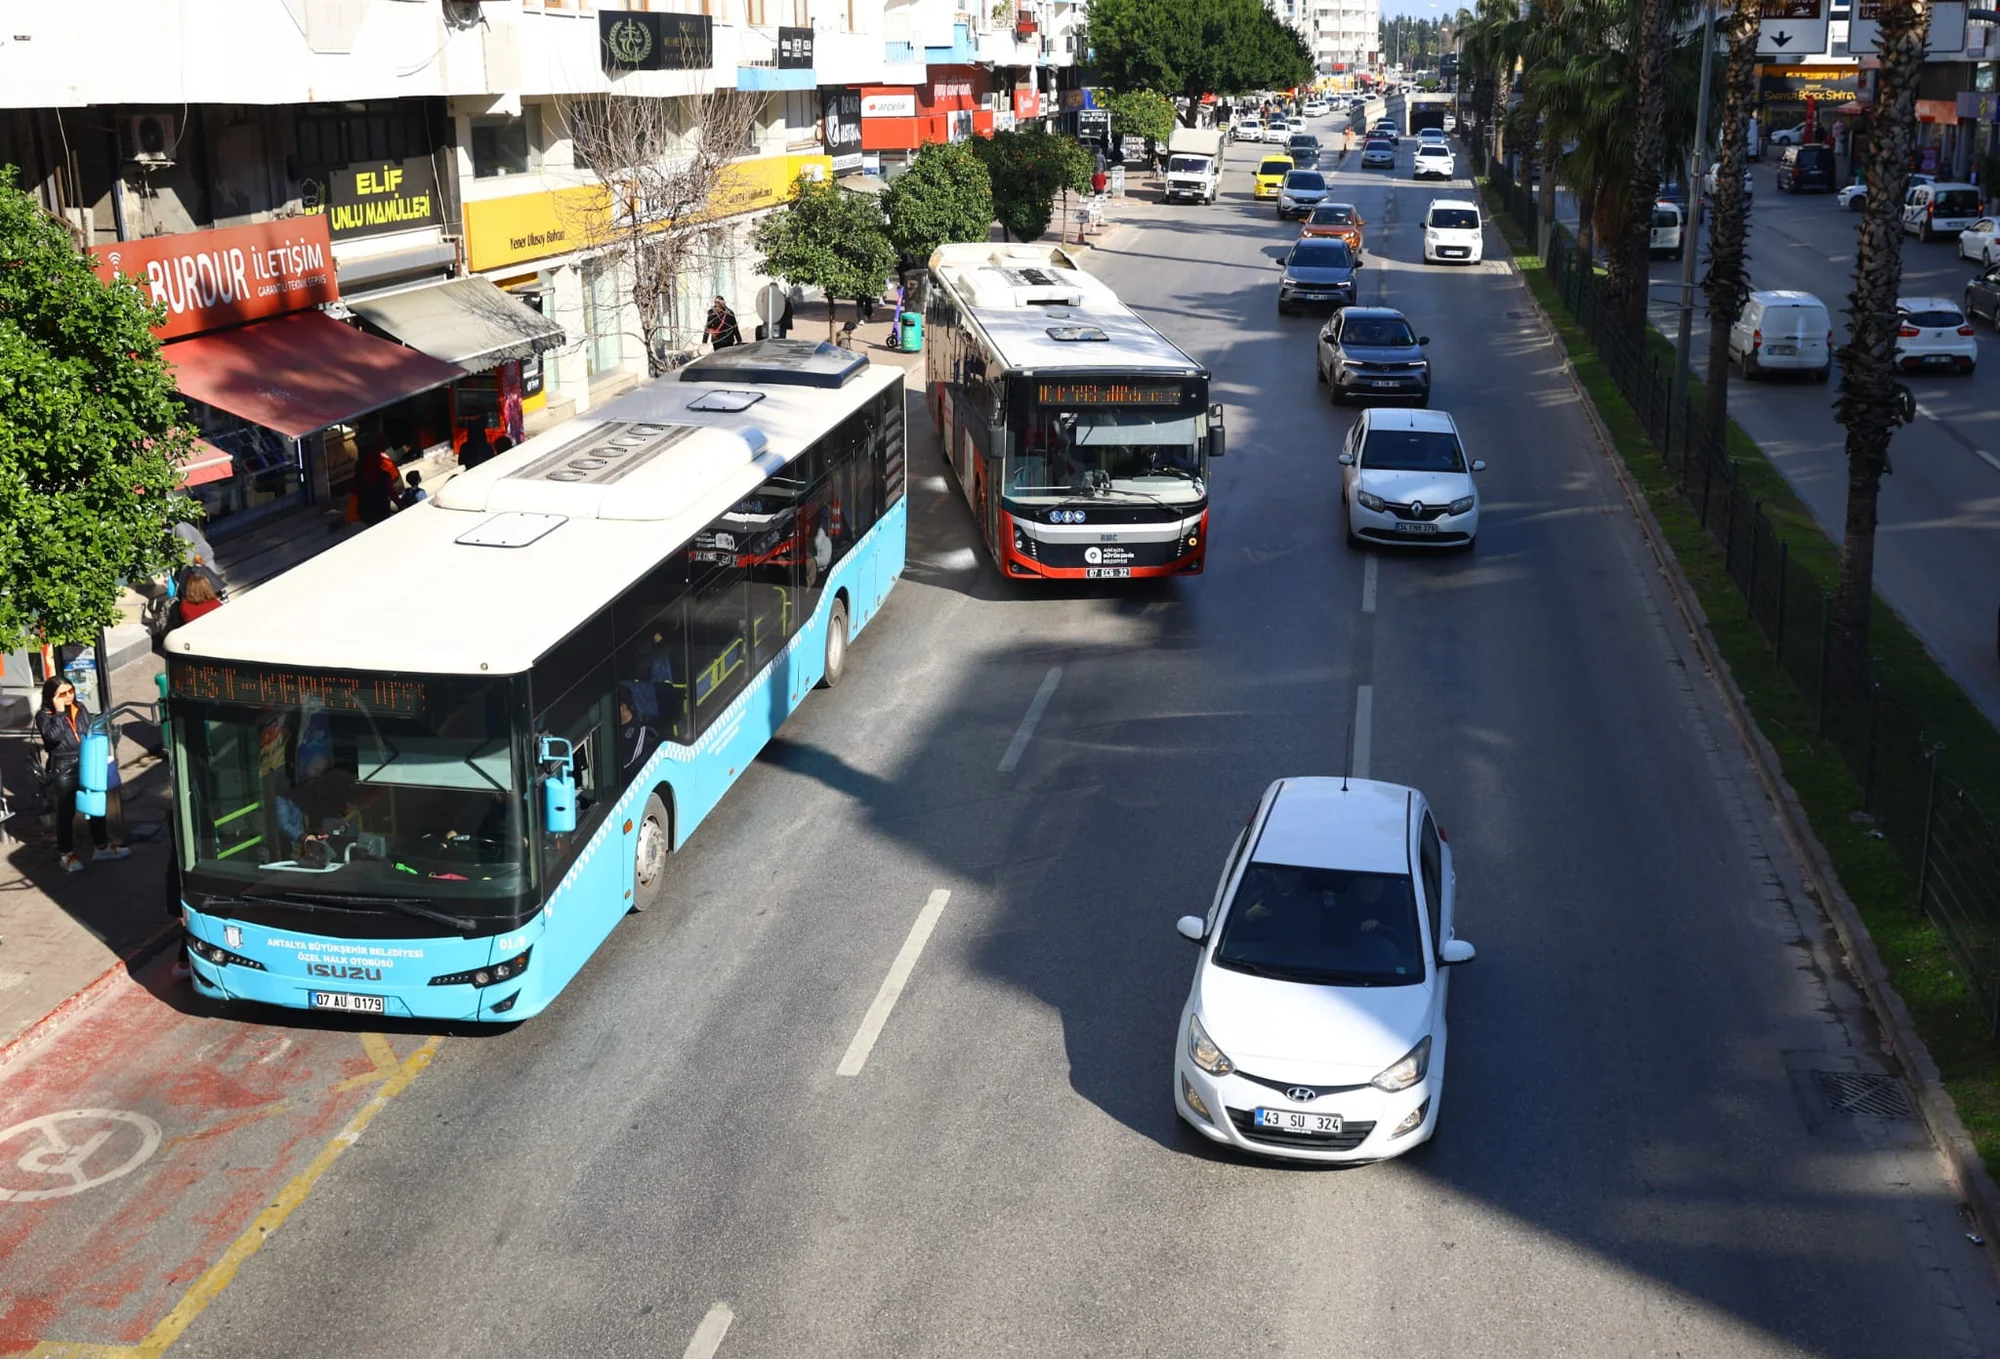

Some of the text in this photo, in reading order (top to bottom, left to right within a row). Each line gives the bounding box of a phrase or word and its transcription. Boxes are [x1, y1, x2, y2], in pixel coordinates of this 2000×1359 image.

[356, 164, 403, 195] ELİF
[331, 189, 431, 230] UNLU MAMÜLLERİ
[509, 237, 526, 250] Yener
[527, 232, 545, 247] Ulusoy
[147, 237, 325, 314] BURDUR İLETİŞİM
[1089, 569, 1098, 577] 07
[267, 938, 424, 959] ANTALYA BÜYÜKŞEHİR BELEDİYESİ
[297, 951, 394, 968] ÖZEL HALK OTOBÜSÜ
[307, 963, 382, 981] ISUZU
[316, 993, 381, 1010] 07 AU 0179
[1264, 1111, 1279, 1125] 43
[1290, 1114, 1305, 1128] SU
[1316, 1117, 1339, 1131] 324
